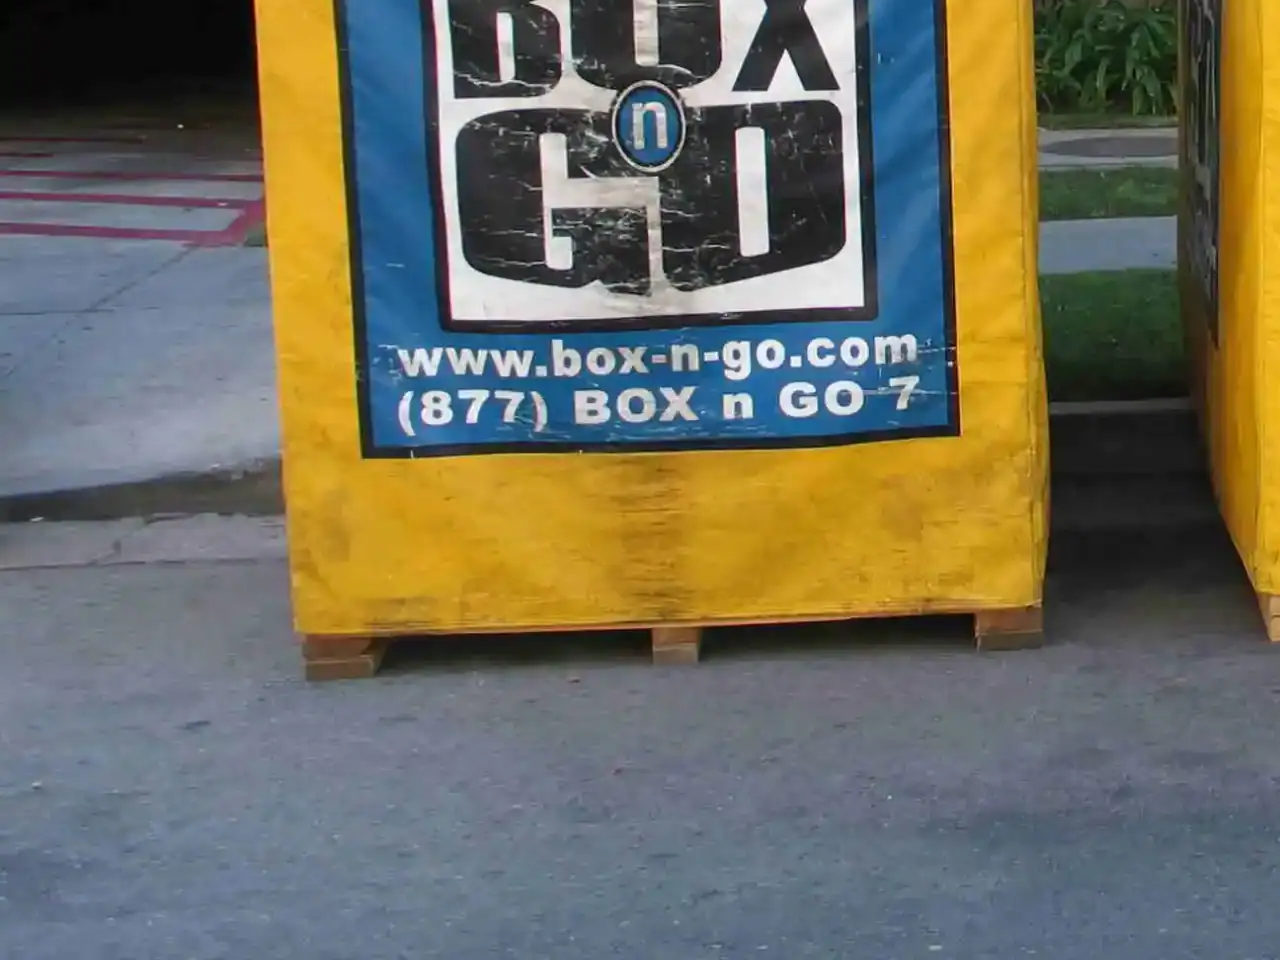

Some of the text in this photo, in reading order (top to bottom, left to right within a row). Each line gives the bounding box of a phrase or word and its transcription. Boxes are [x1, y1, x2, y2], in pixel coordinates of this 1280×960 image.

[631, 101, 669, 150] n
[455, 99, 847, 297] GO
[398, 331, 919, 381] www.box-n-go.com
[398, 376, 920, 436] (877) BOX n GO 7
